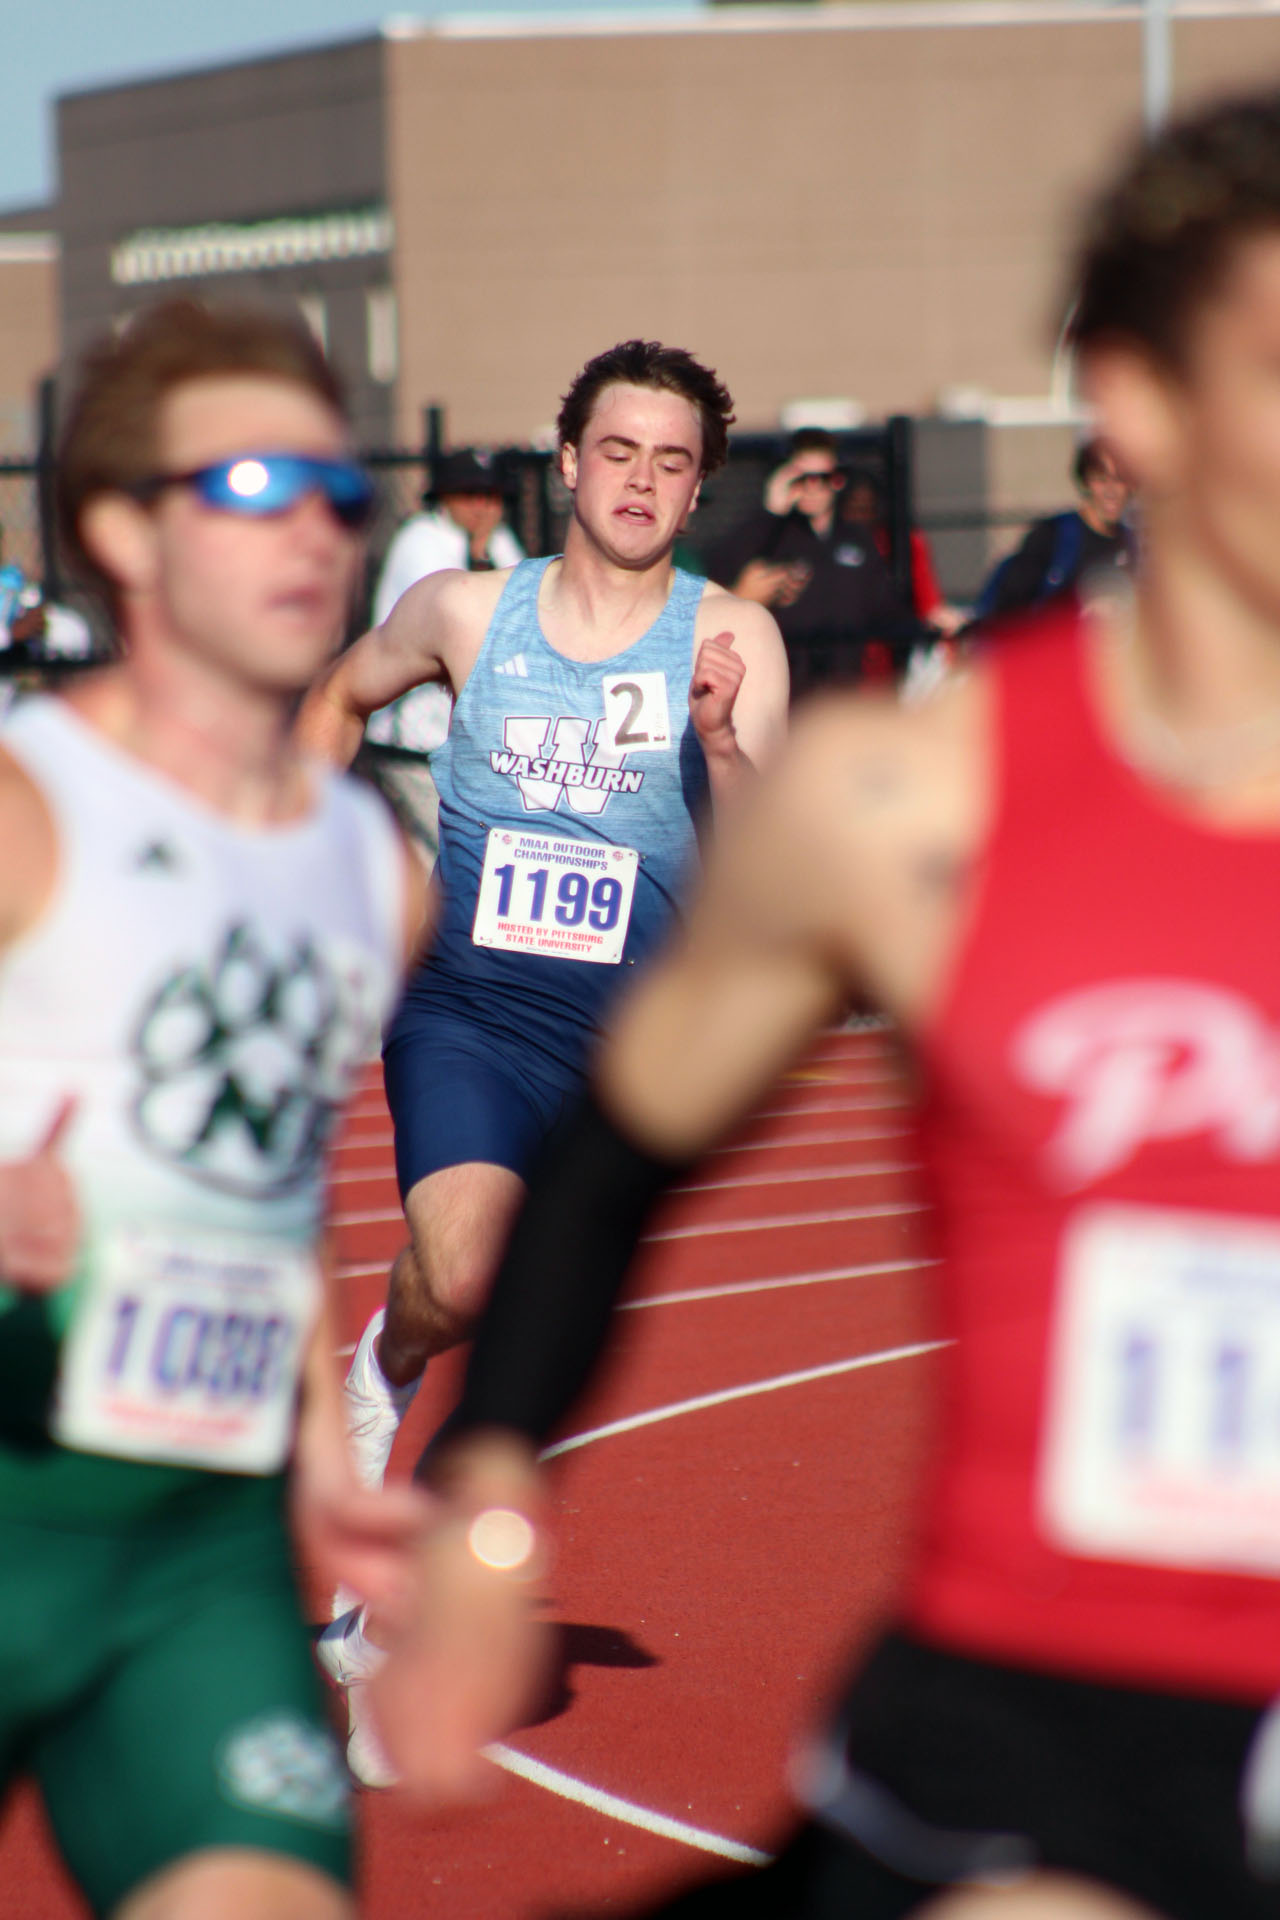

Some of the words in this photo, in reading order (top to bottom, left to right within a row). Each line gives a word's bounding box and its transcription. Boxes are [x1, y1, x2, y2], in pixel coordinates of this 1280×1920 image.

[610, 682, 649, 746] 2
[490, 751, 645, 793] WASHBURN
[520, 837, 549, 851] MIAA
[553, 842, 606, 858] OUTDOOR
[514, 848, 608, 871] CHAMPIONSHIPS
[494, 864, 623, 931] 1199
[497, 922, 534, 935] HOSTED
[536, 927, 548, 937] BY
[551, 929, 604, 945] PITTSBURG
[505, 933, 534, 946] STATE
[537, 937, 593, 953] UNIVERSITY
